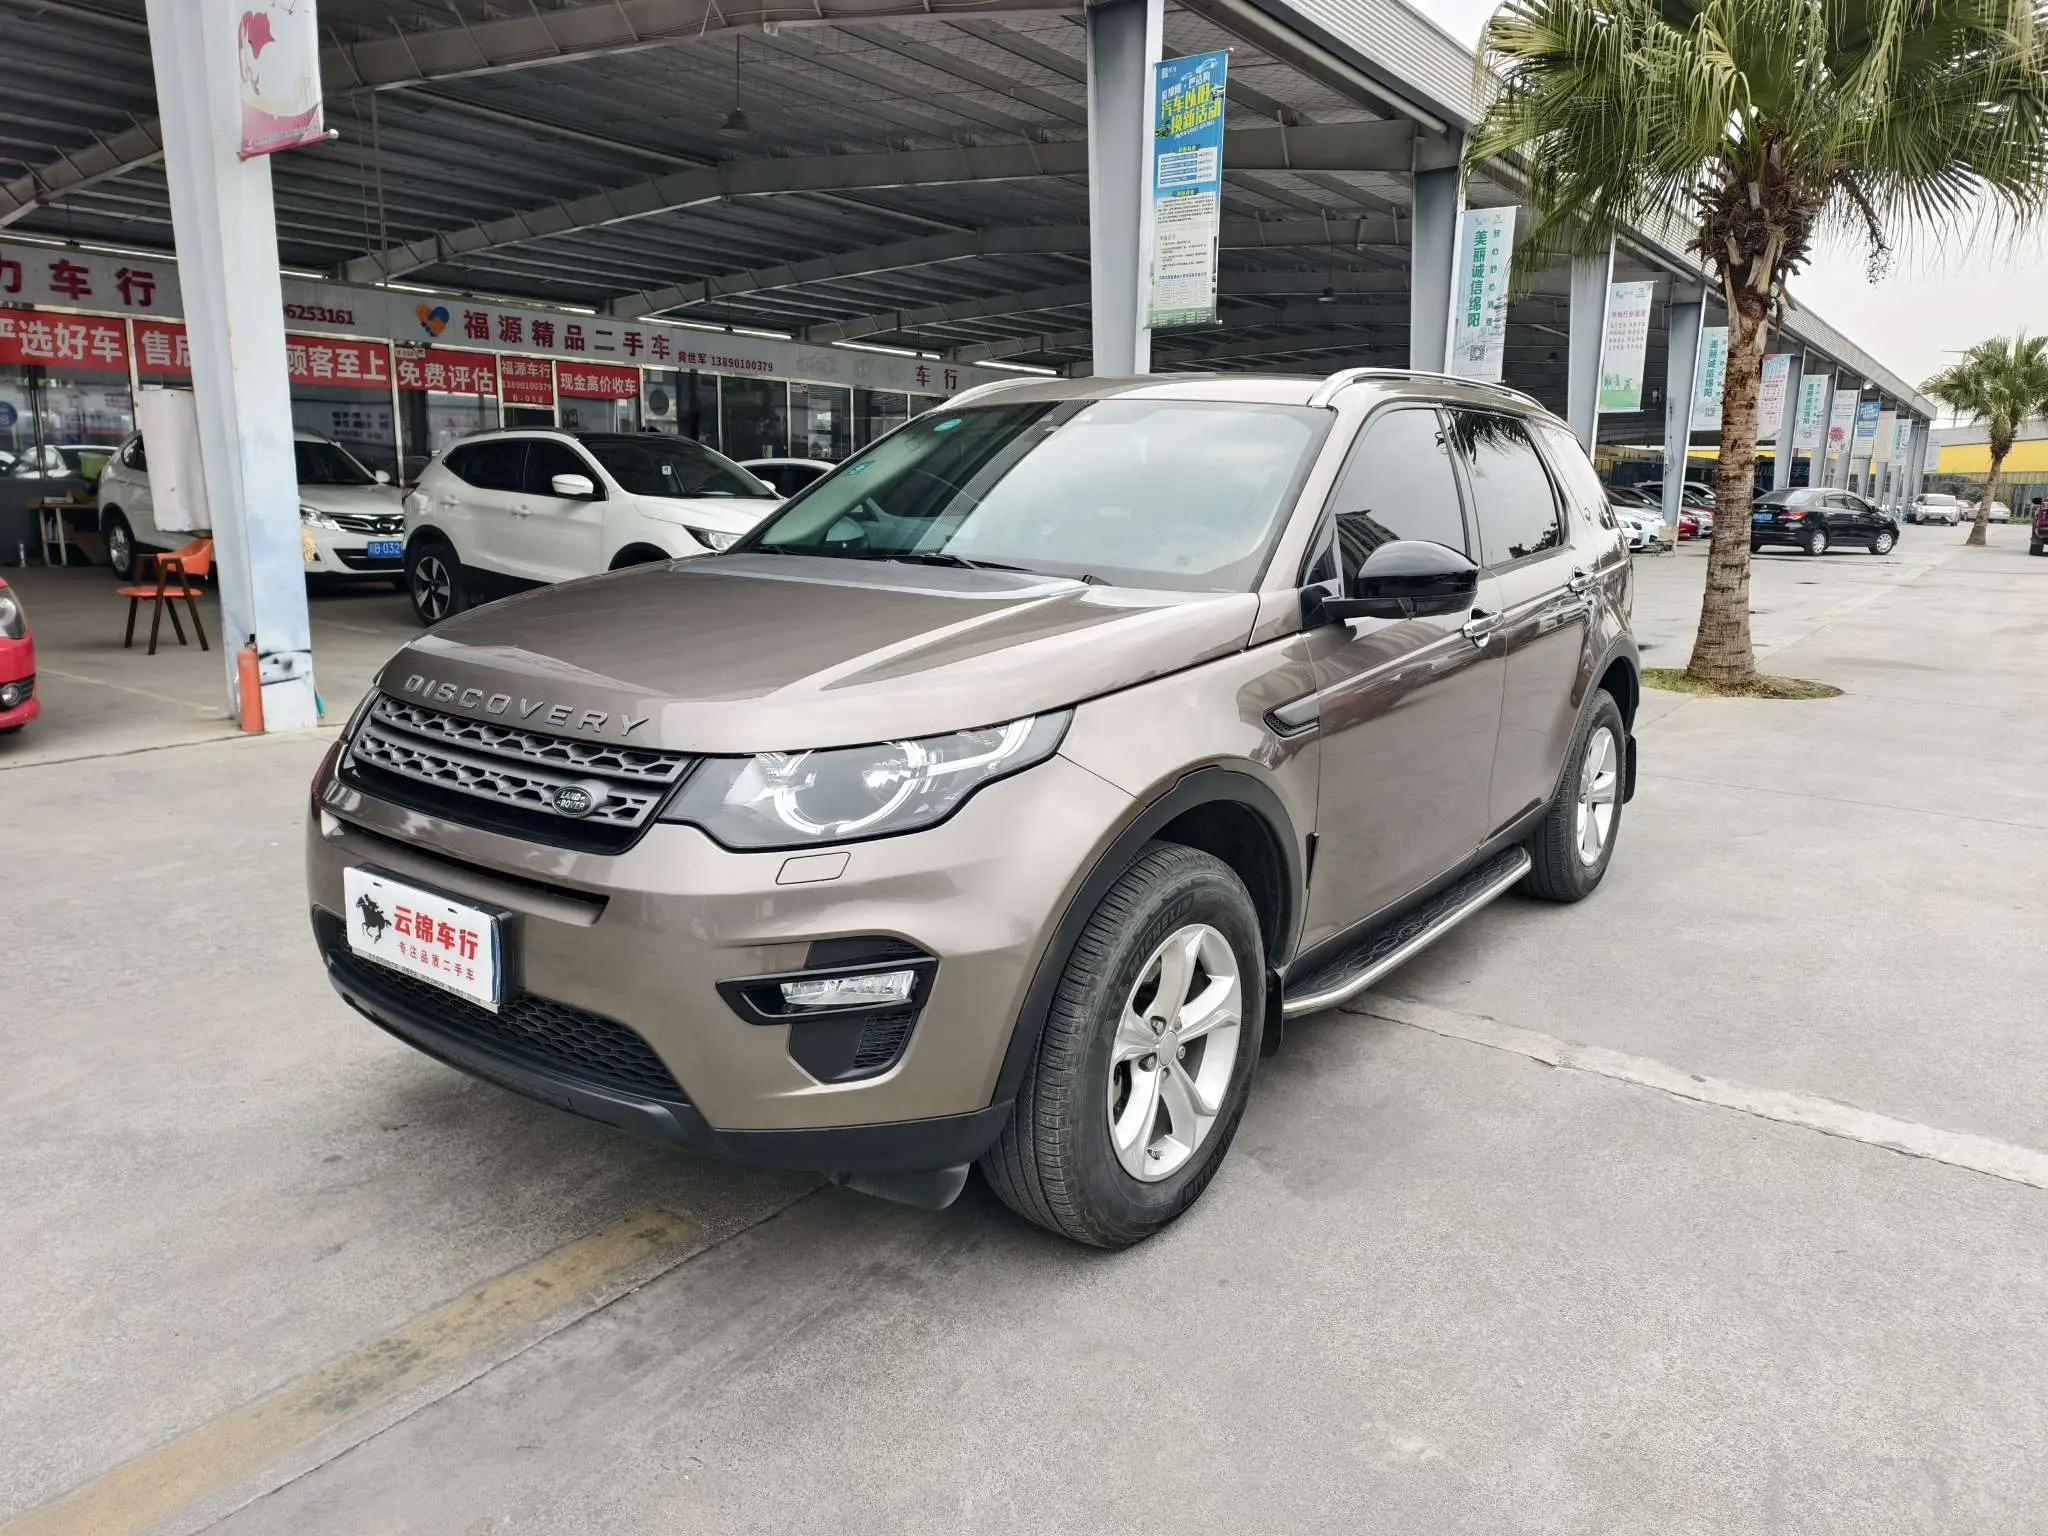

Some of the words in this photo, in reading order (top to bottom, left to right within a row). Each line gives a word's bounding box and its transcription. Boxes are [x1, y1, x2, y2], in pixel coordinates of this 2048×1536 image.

[1467, 230, 1488, 328] 美丽诚信绵阳
[464, 309, 670, 359] 福源精品二手车
[286, 344, 387, 381] 顾客至上
[398, 360, 494, 393] 免费评估
[502, 359, 551, 378] 福源车行
[711, 356, 773, 372] 13890100379
[502, 380, 552, 392] 13890100379
[560, 372, 637, 395] 现金高价收车
[403, 674, 650, 736] DISCOVERY
[560, 791, 581, 801] LAND
[560, 799, 586, 811] ROVER
[394, 905, 479, 961] 云锦车行
[399, 941, 475, 981] 专注品质二手车
